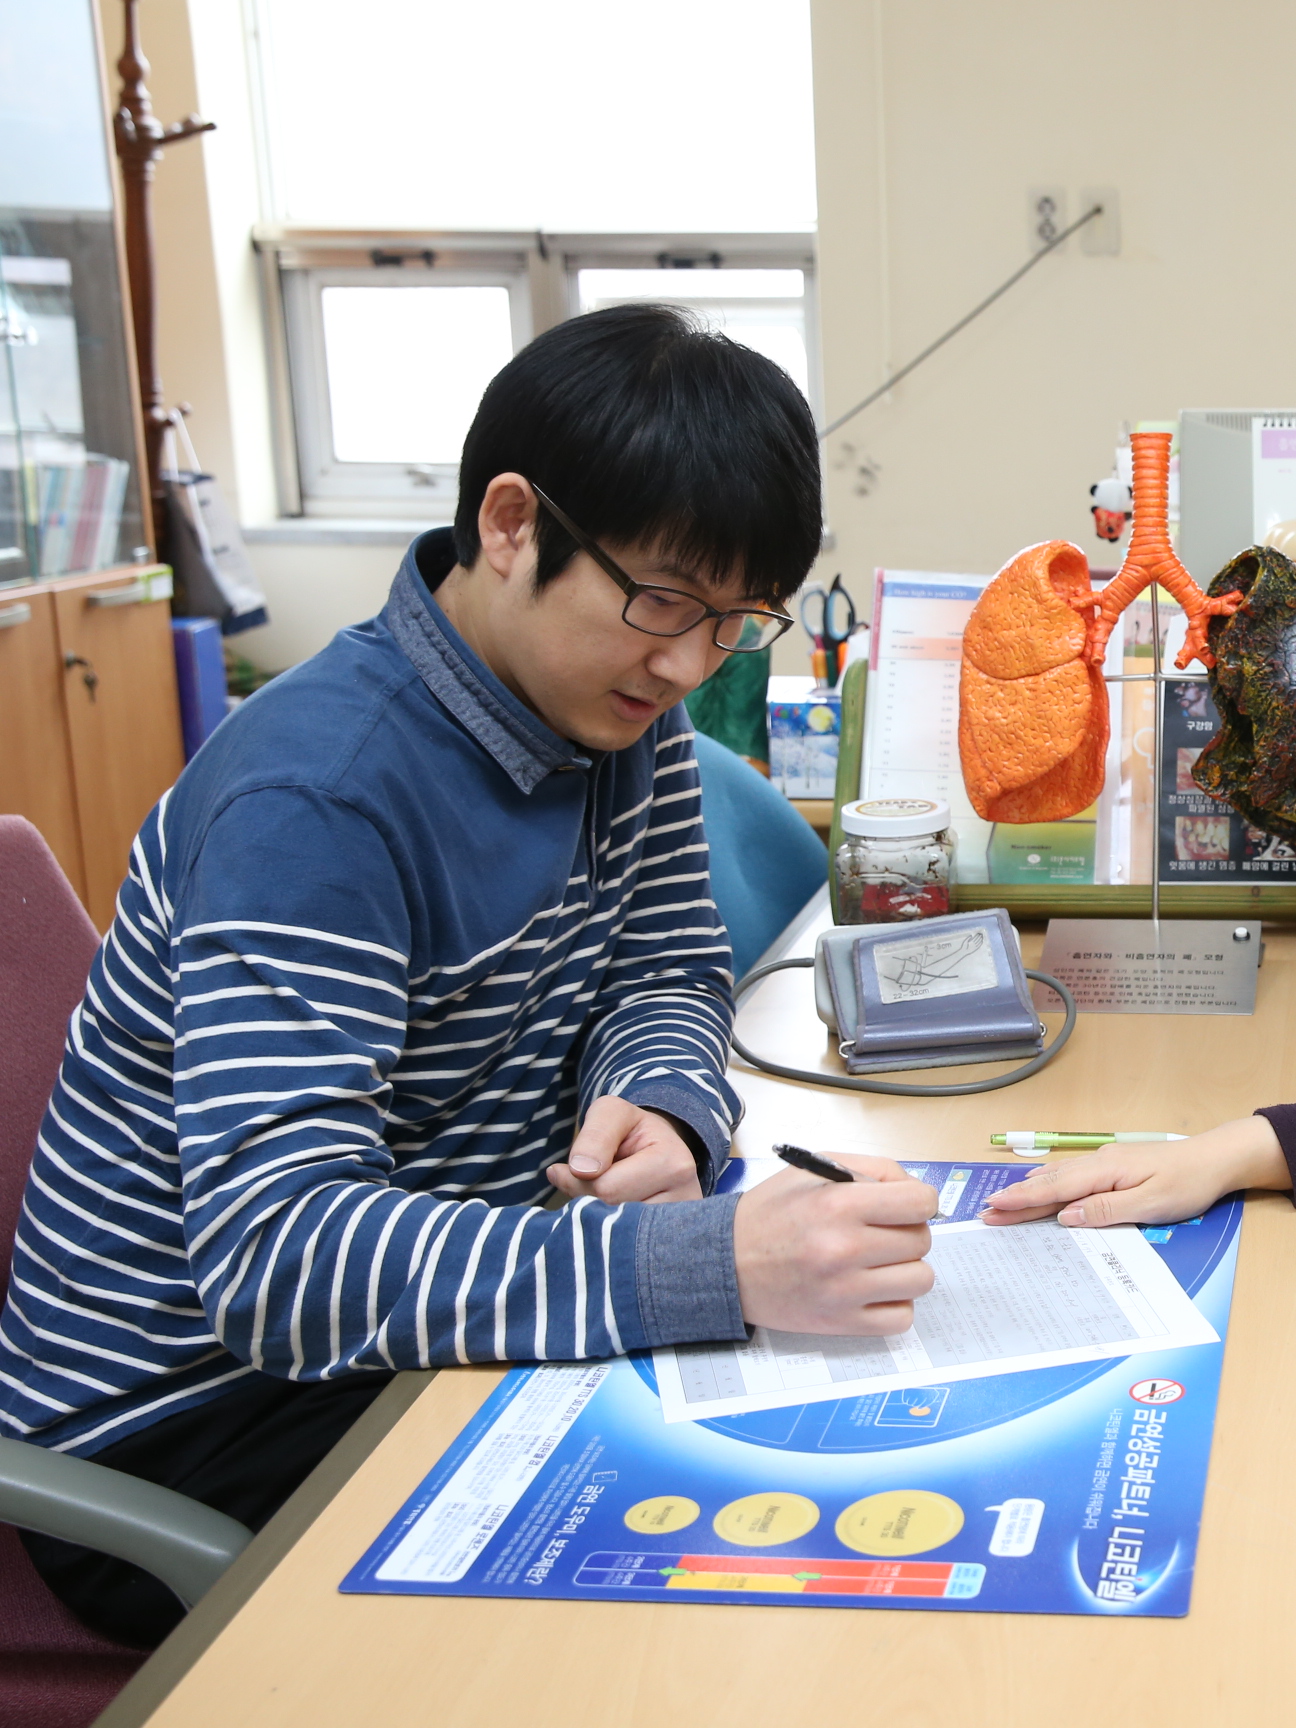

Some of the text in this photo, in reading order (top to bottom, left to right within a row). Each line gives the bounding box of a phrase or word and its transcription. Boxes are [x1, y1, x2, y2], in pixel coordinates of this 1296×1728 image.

[1186, 720, 1213, 732] 구강암
[1168, 861, 1196, 871] 잇몸에
[1198, 861, 1216, 871] 생긴
[1242, 861, 1269, 871] 폐암에
[1271, 861, 1289, 872] 걸린
[584, 1365, 609, 1389] 니코틴엘
[533, 1434, 560, 1460] 니코틴엘
[1082, 1407, 1124, 1529] 니코틴엘과 함께하면 금연이 쉬워집니다
[576, 1484, 605, 1504] 금연
[1095, 1408, 1168, 1603] 금연성공파트너, 니코틴엘
[480, 1504, 509, 1531] 니코틴엘
[553, 1506, 590, 1536] 도우미,
[524, 1539, 570, 1586] 보조제란?
